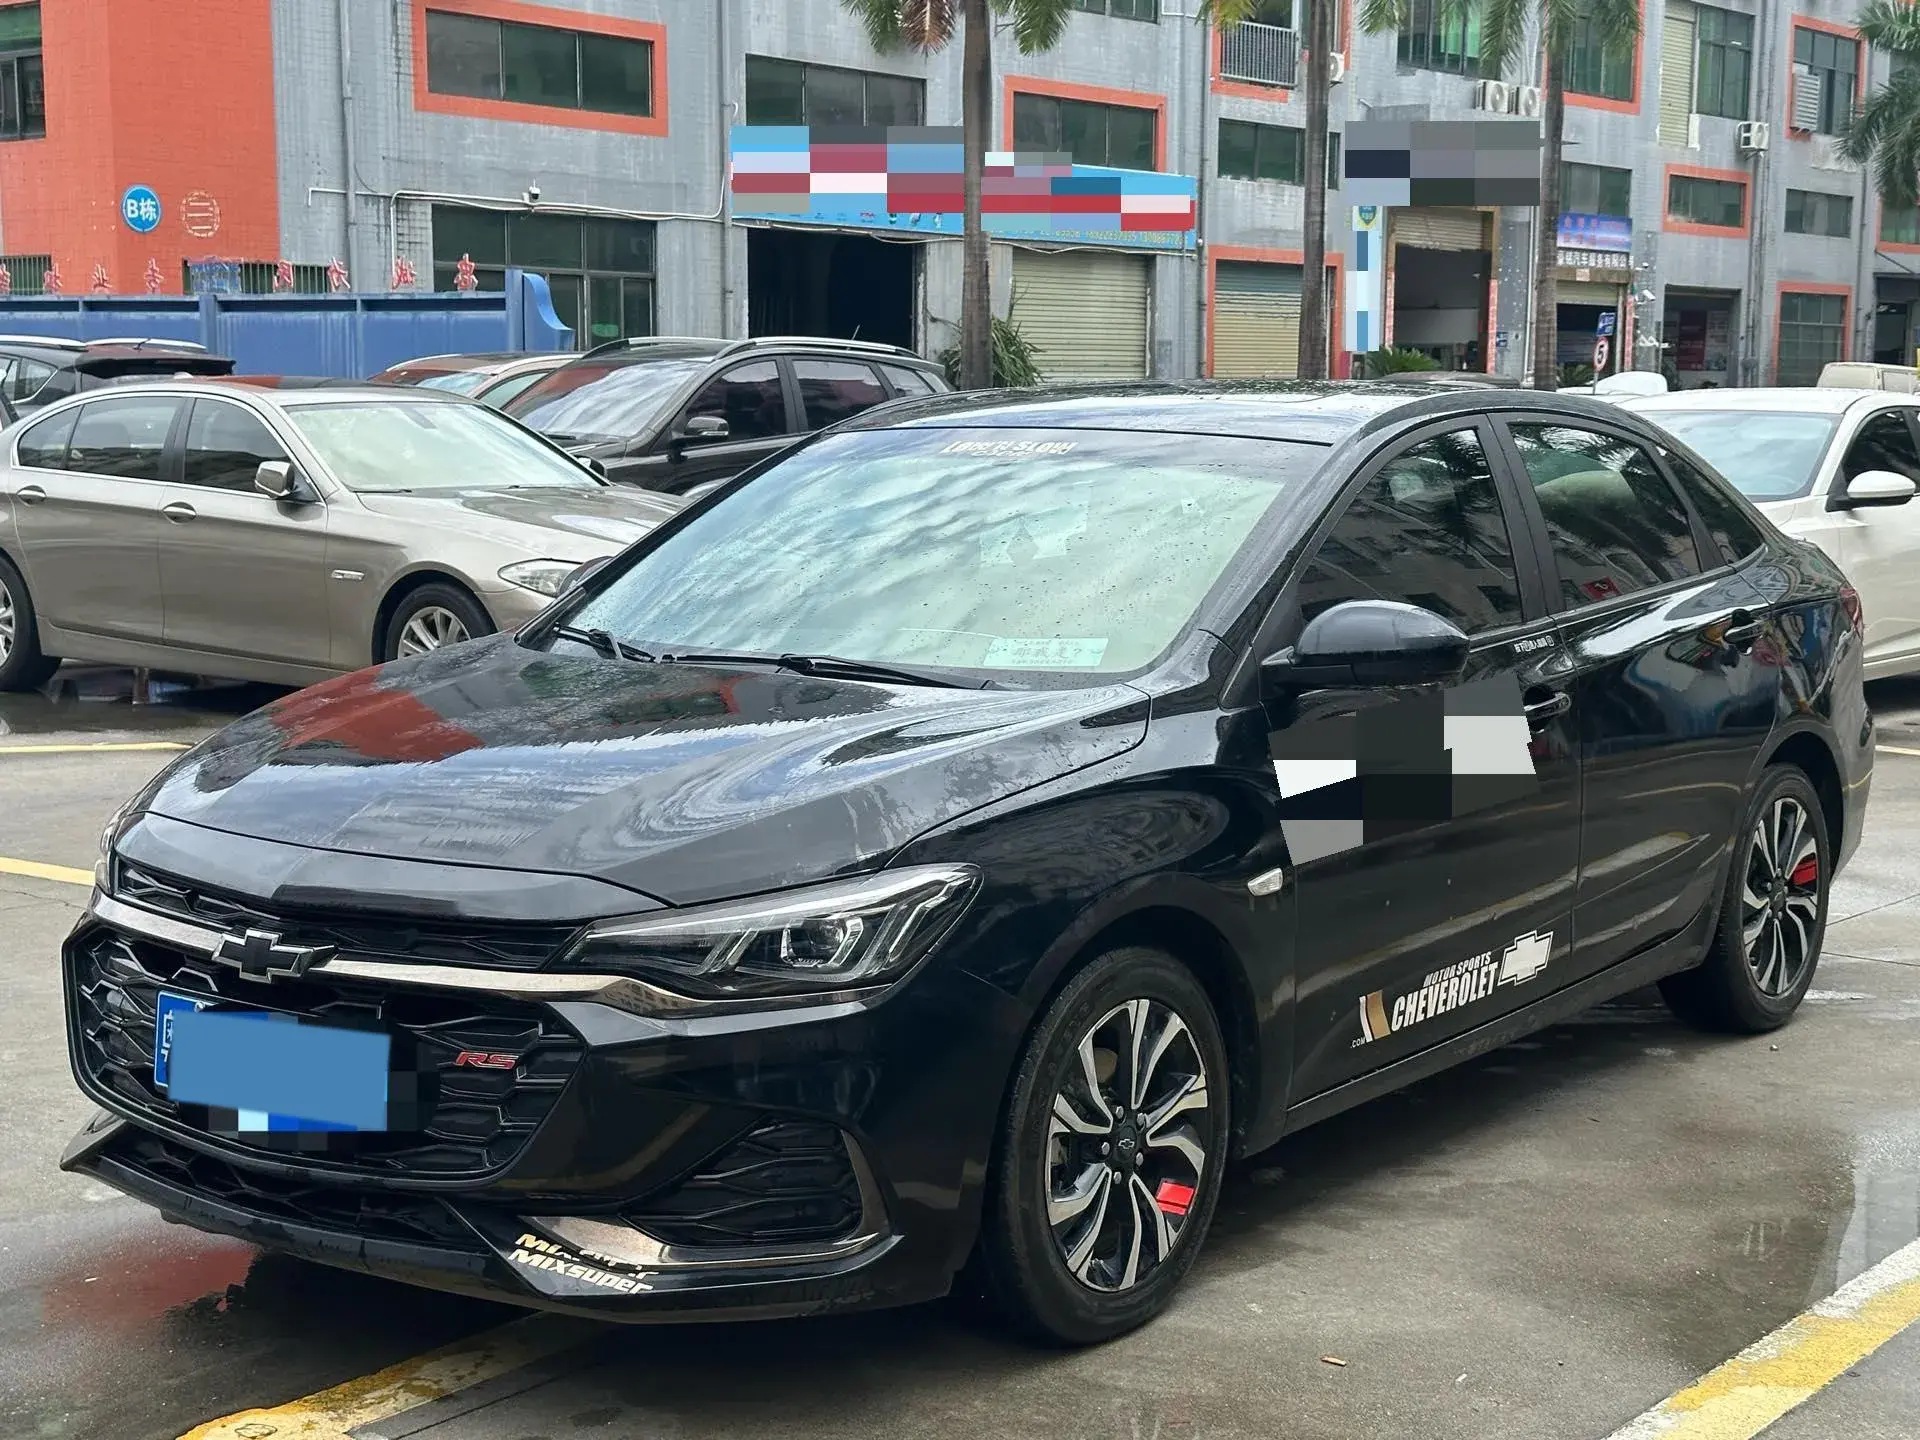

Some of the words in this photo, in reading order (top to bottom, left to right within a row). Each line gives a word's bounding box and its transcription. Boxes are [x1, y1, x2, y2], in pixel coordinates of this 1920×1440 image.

[125, 198, 157, 222] B栋
[1596, 344, 1605, 364] 5
[1391, 961, 1499, 1032] CHEVEROLET
[456, 1051, 519, 1070] RS
